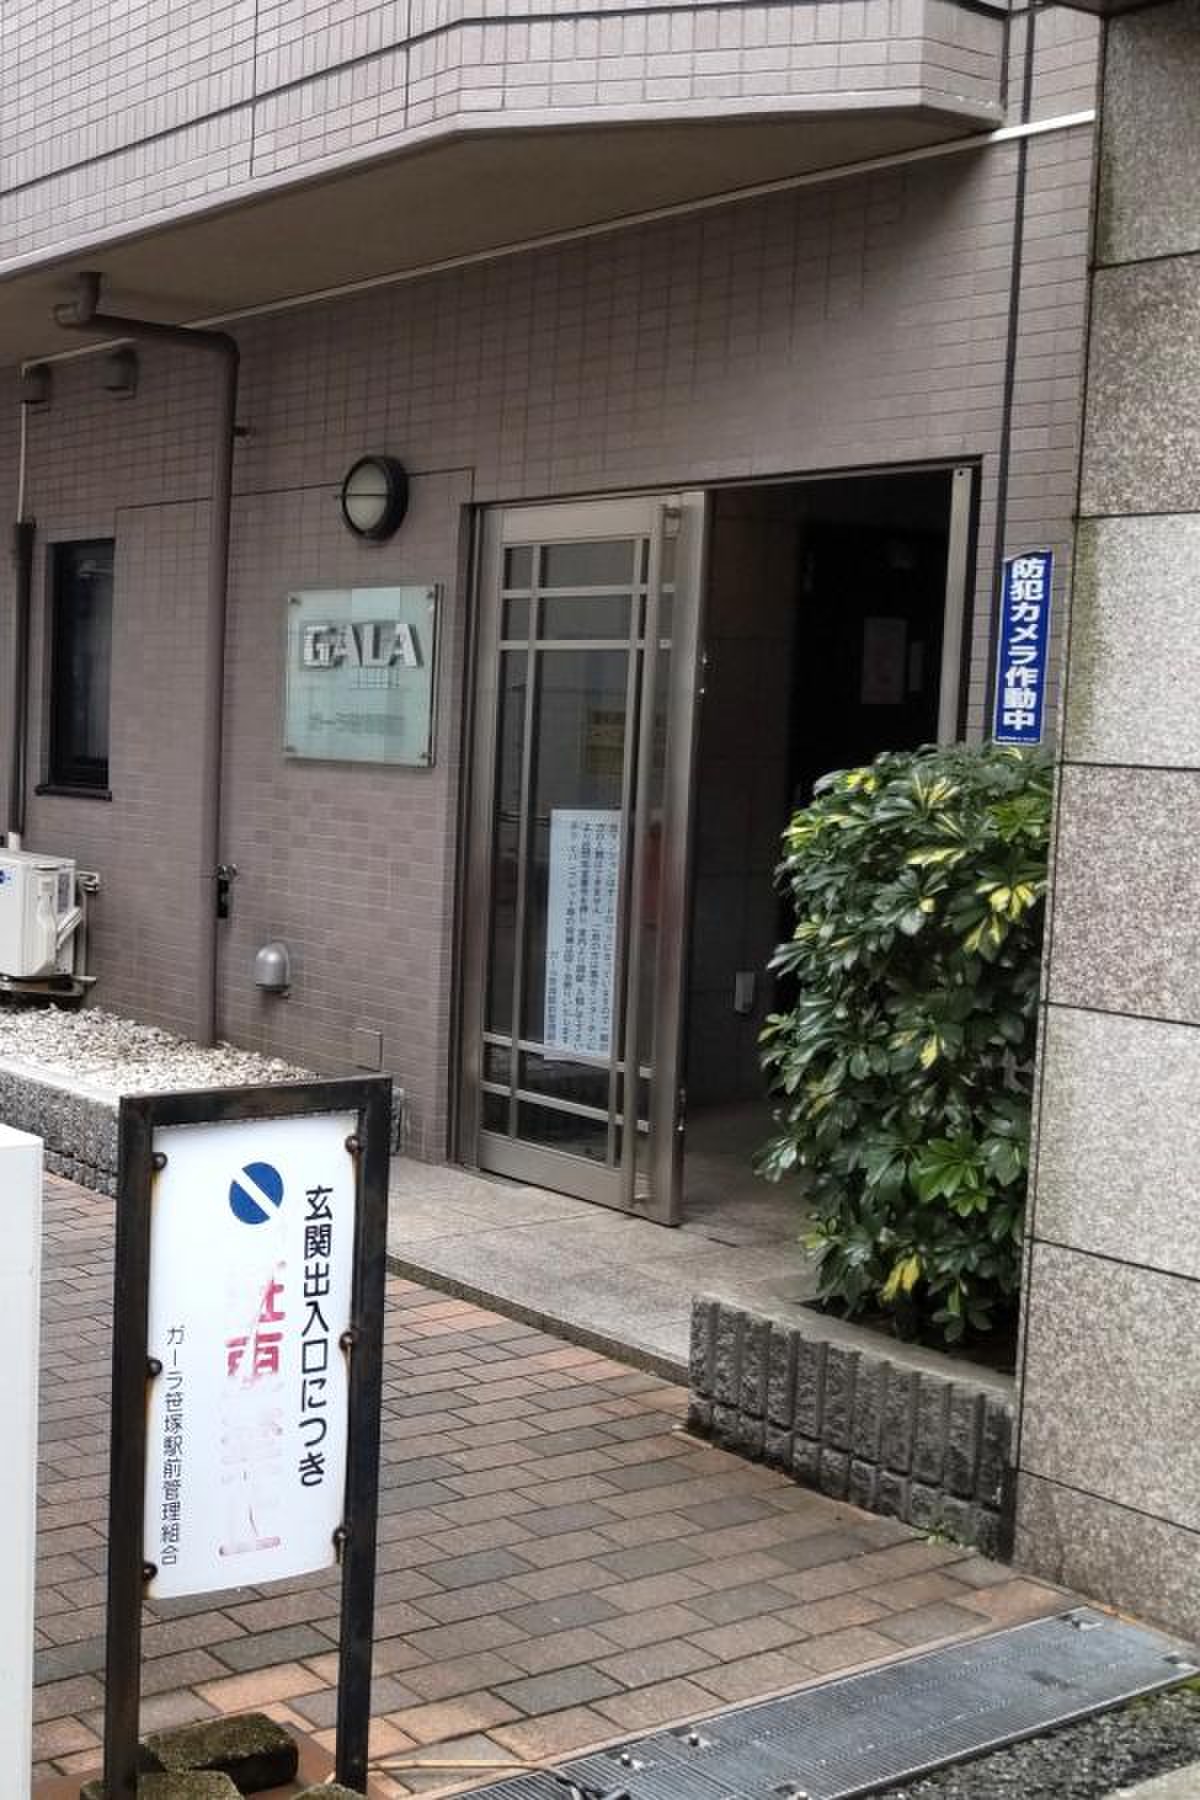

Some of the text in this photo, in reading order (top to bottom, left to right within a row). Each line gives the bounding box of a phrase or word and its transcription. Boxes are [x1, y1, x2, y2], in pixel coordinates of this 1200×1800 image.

[303, 623, 423, 668] GALA
[1003, 558, 1046, 730] 防犯カメラ作動中
[299, 1185, 333, 1487] 玄関出入口につき
